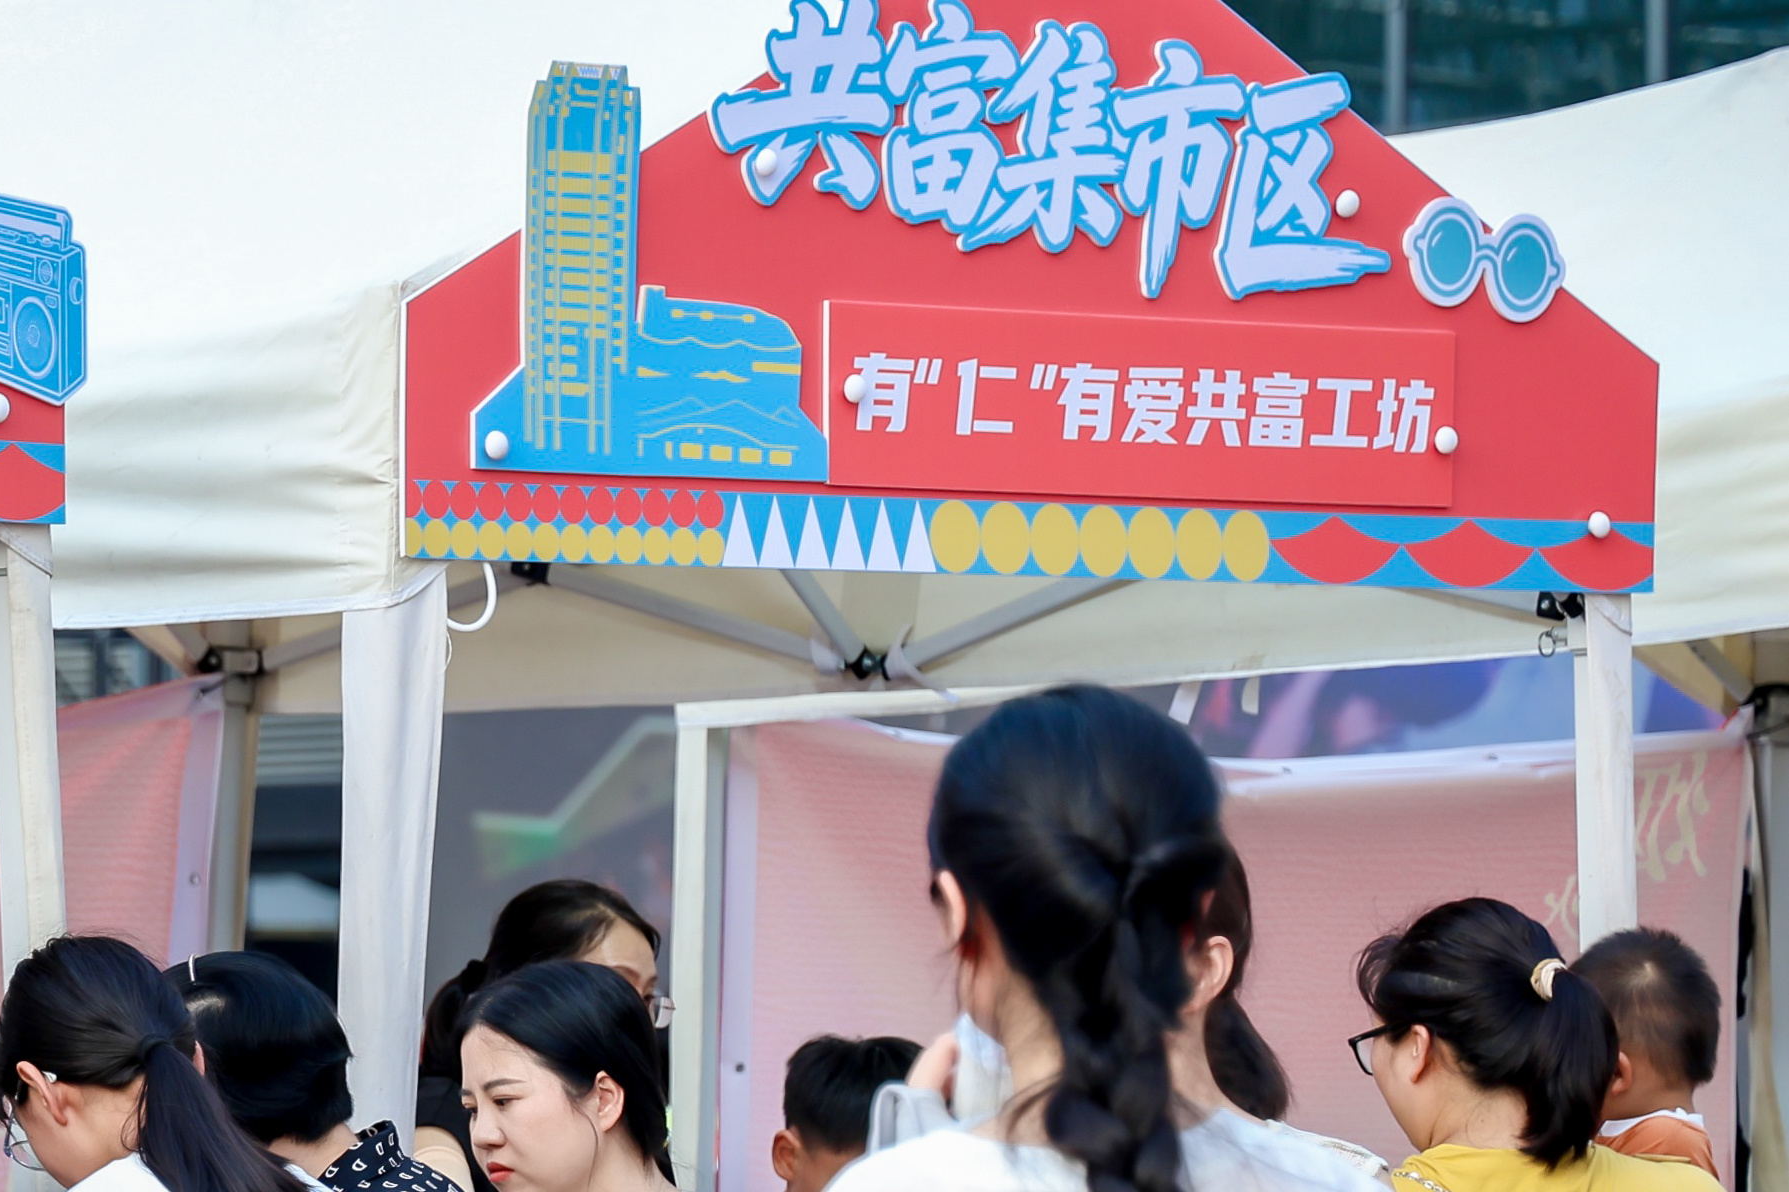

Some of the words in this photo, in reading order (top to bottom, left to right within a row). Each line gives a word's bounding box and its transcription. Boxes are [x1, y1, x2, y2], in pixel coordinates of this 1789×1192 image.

[709, 0, 1390, 299] 共富集市区
